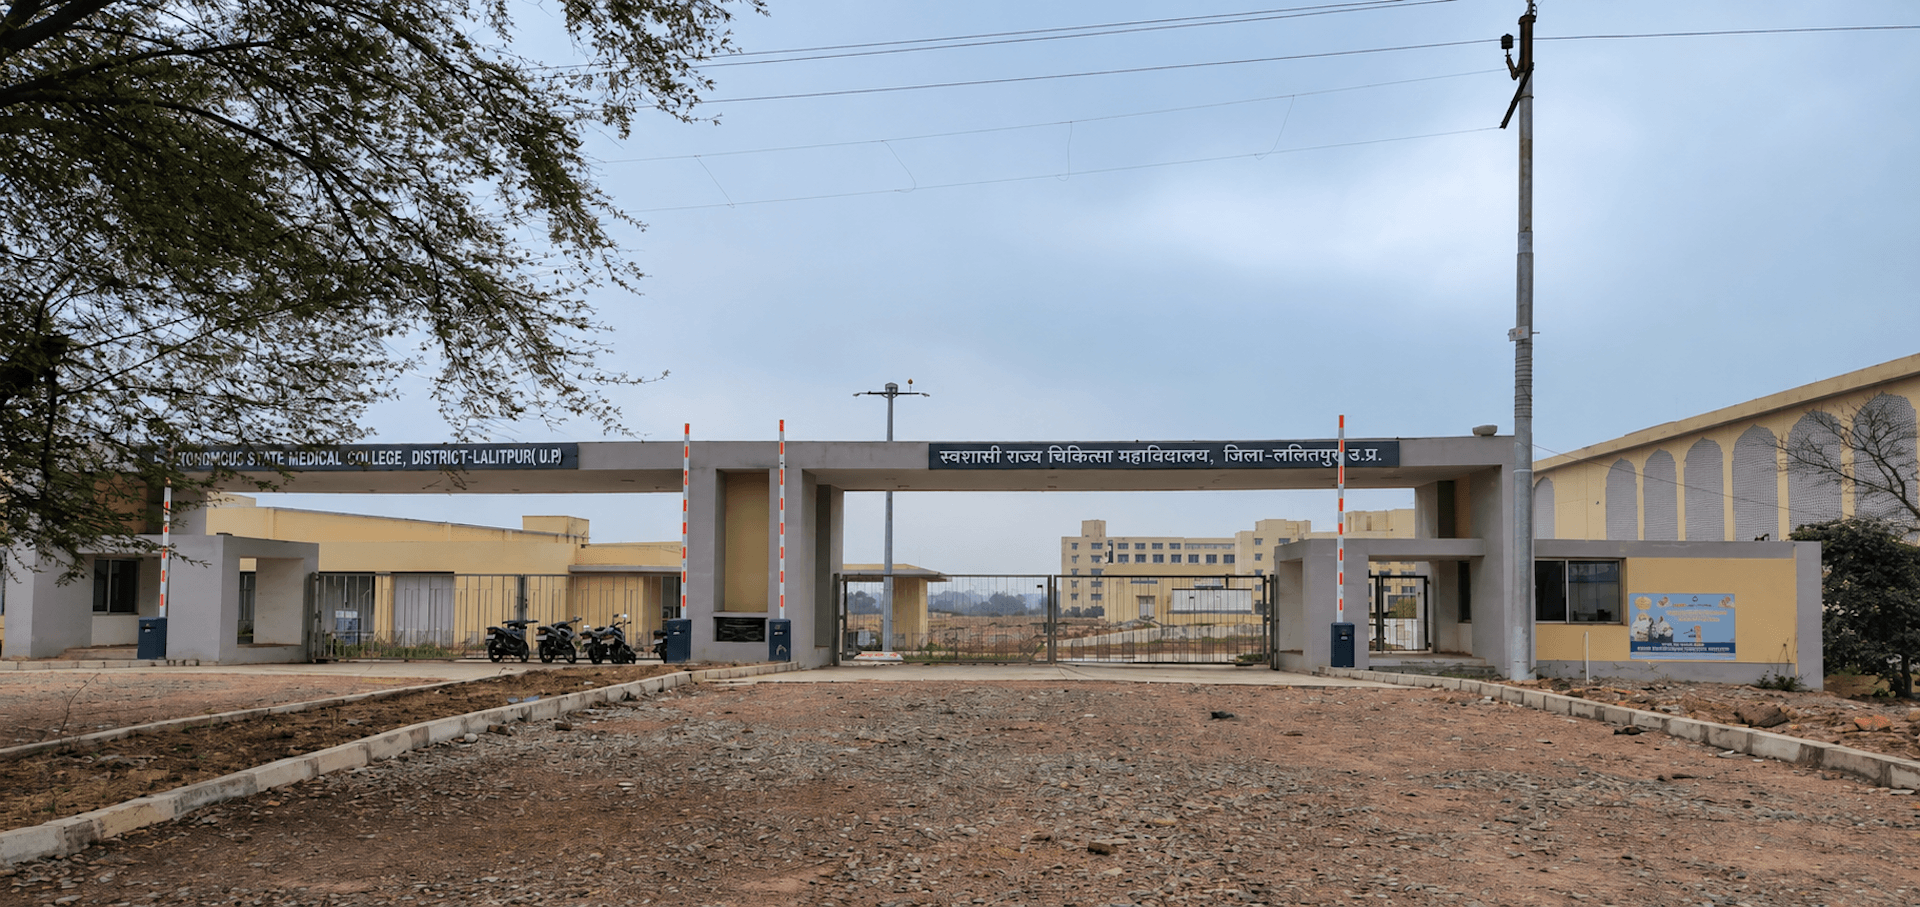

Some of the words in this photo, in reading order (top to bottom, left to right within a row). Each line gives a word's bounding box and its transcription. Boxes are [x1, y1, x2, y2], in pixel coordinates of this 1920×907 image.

[288, 450, 342, 466] MEDICAL
[347, 450, 406, 468] COLLEGE,
[939, 445, 1001, 464] स्वशासी
[1006, 450, 1043, 464] राज्य
[1048, 445, 1114, 464] चिकित्सा
[1348, 448, 1383, 463] उ.प्र.
